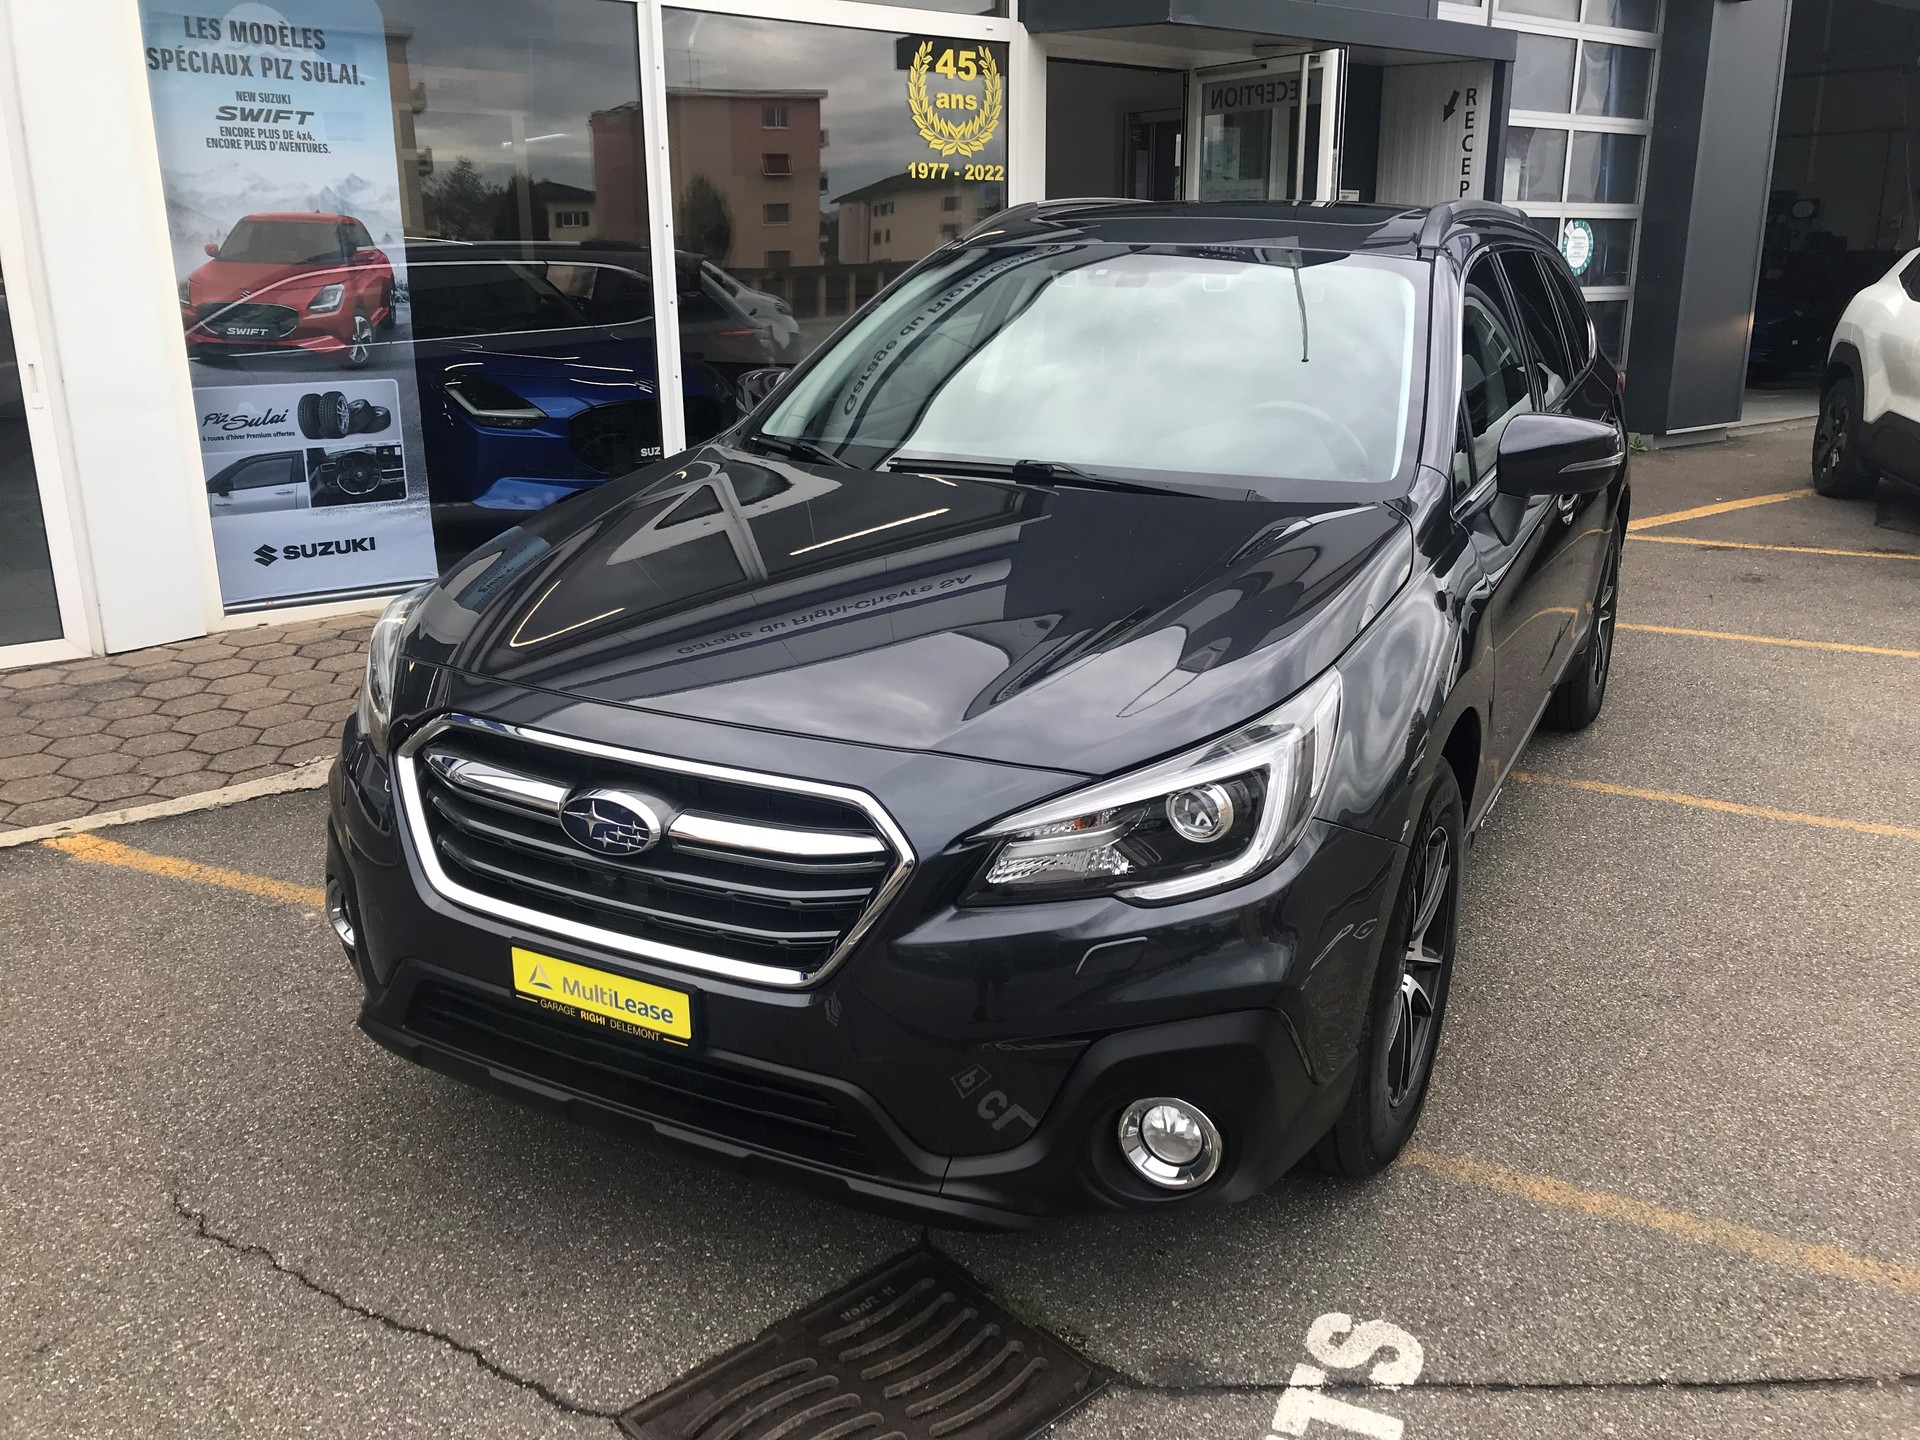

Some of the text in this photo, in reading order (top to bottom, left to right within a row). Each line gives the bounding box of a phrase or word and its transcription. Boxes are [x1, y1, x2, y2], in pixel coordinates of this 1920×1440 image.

[183, 15, 326, 50] LES MODÈLES
[146, 45, 366, 86] SPÉCIAUX PIZ SULAI.
[935, 48, 978, 81] 45
[235, 90, 291, 105] NEW SUZUKI
[935, 91, 978, 111] ans
[215, 105, 314, 125] SWIFT
[219, 126, 256, 139] ENCORE
[257, 128, 281, 140] PLUS
[282, 129, 295, 141] DE
[1459, 87, 1478, 198] RECEP
[206, 137, 331, 154] ENCORE PLUS D'AVENTURES.
[907, 162, 949, 180] 1977
[964, 164, 1005, 182] 2022
[226, 327, 269, 336] SWIFT
[202, 408, 289, 431] Piz Sulai
[226, 433, 245, 441] d'hiver
[246, 432, 272, 440] Premium
[640, 446, 661, 457] SUZ
[283, 537, 376, 561] SUZUKI
[562, 976, 674, 1024] MultiLease
[540, 998, 660, 1042] GARAGE RIGHI DELEMONT
[1262, 1312, 1424, 1440] TS
